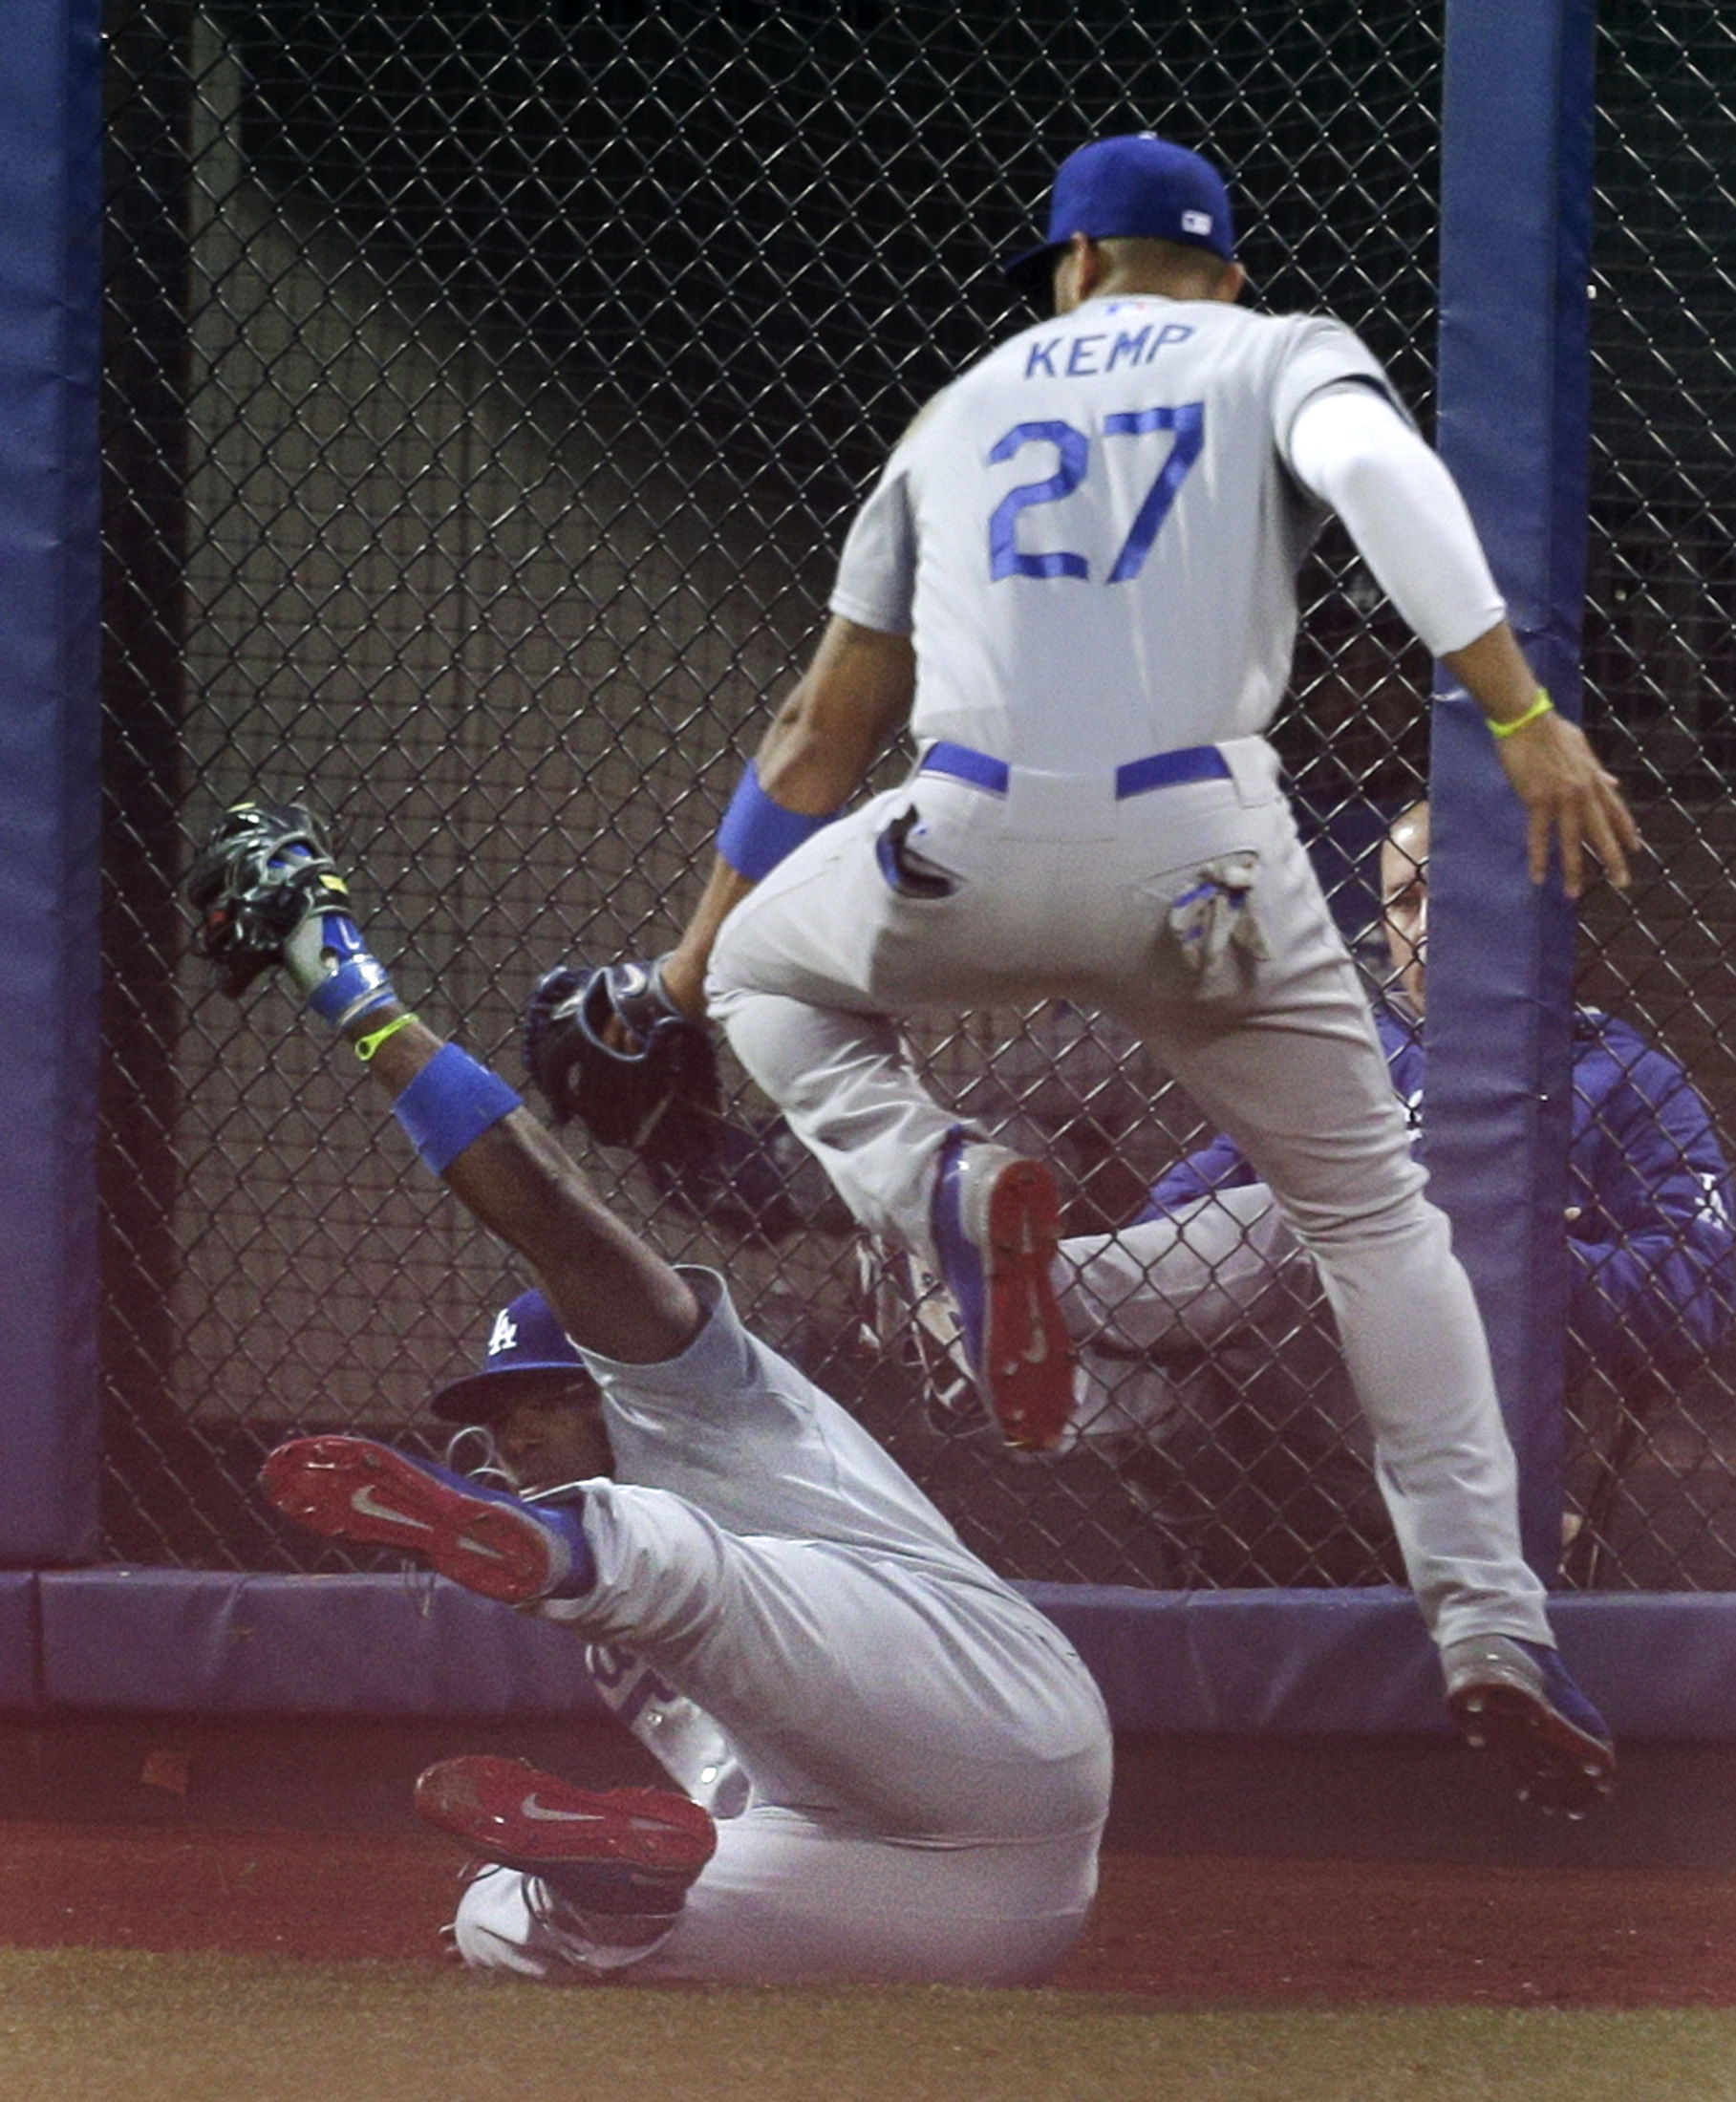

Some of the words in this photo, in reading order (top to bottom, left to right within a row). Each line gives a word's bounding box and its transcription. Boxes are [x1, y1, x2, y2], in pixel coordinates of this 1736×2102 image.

[1025, 324, 1194, 379] KEMP
[988, 401, 1205, 585] 27
[487, 1307, 518, 1356] LA
